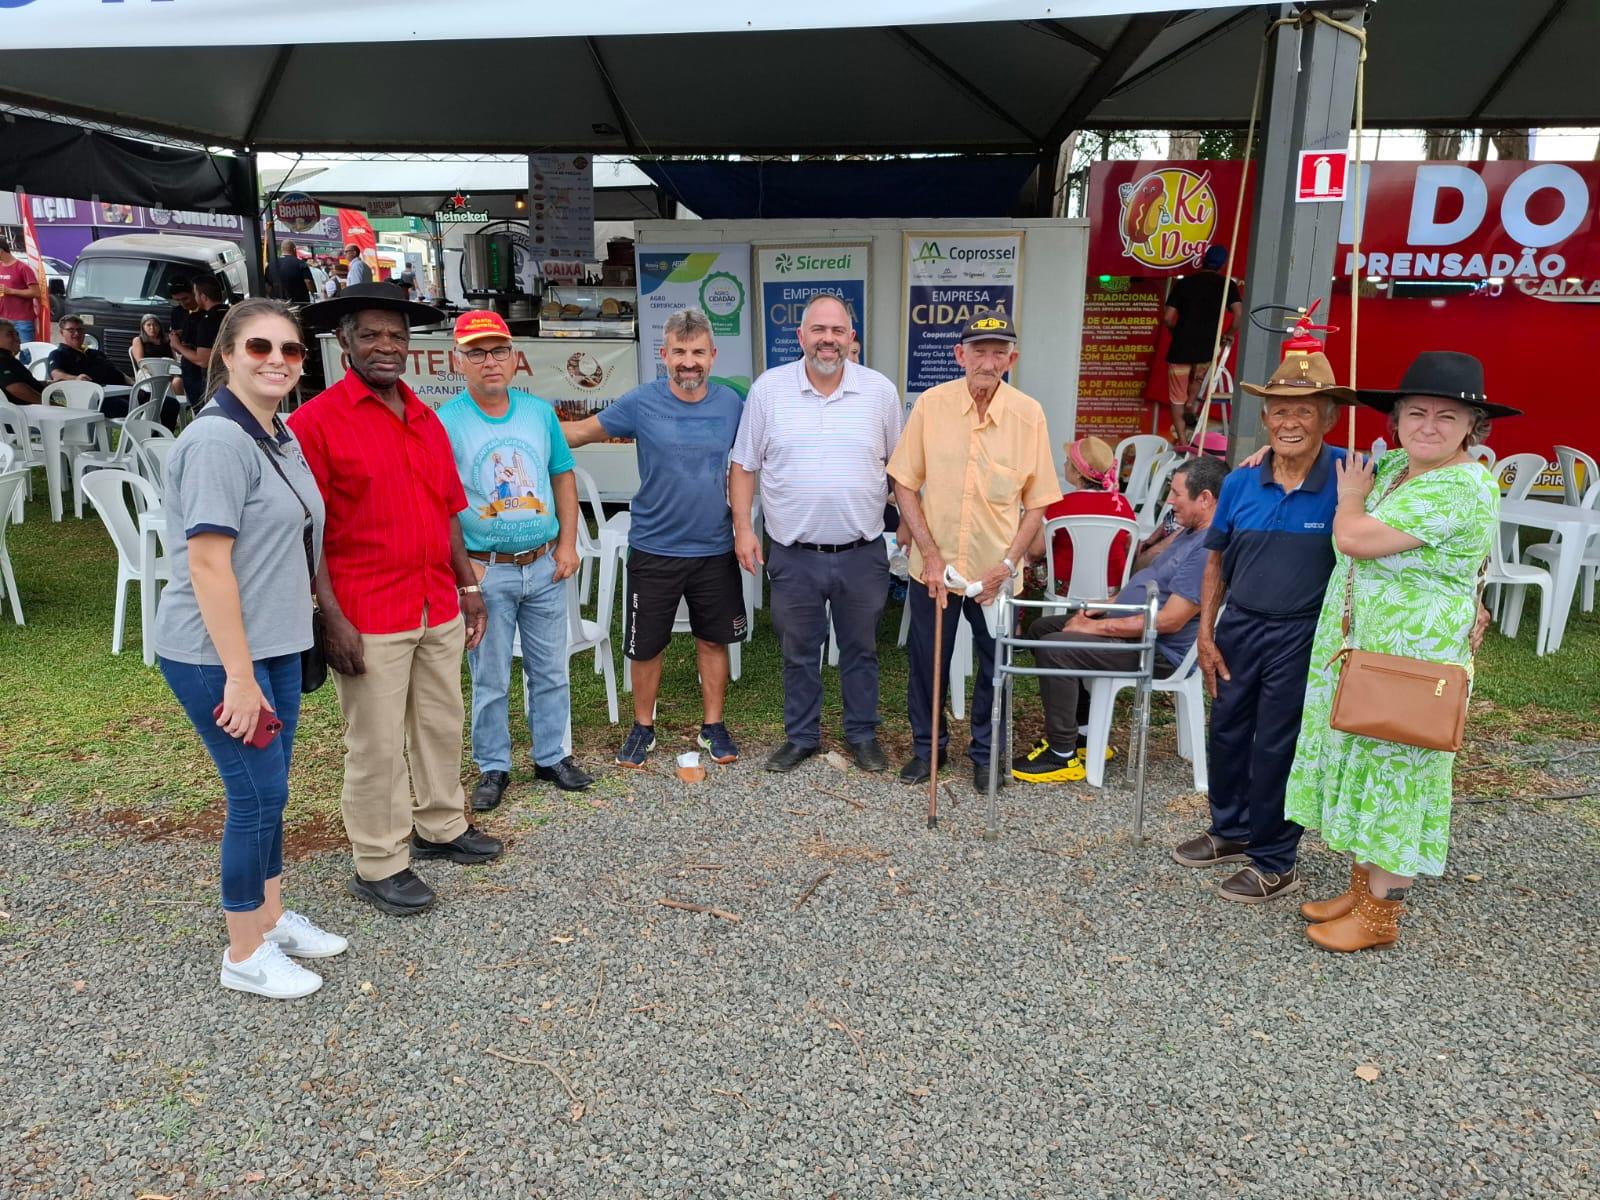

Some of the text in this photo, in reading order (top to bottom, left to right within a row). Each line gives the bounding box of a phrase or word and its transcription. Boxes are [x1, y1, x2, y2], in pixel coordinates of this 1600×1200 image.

[1173, 169, 1212, 225] Ki
[279, 204, 318, 217] BRAHMA
[435, 211, 488, 222] Heineken
[949, 246, 1016, 263] Coprossel
[1160, 230, 1209, 268] Dog
[544, 261, 582, 276] CAIXA
[796, 254, 851, 270] Sicredi
[1344, 247, 1566, 278] PRENSADÃO
[783, 287, 845, 300] EMPRESA
[1519, 279, 1600, 296] CAIXA
[931, 290, 990, 302] EMPRESA
[1093, 293, 1159, 301] TRADICIONAL
[1088, 317, 1158, 325] DE CALABRESA
[922, 331, 962, 339] Cooperativa
[412, 385, 466, 395] LARANJE
[504, 498, 519, 509] 90
